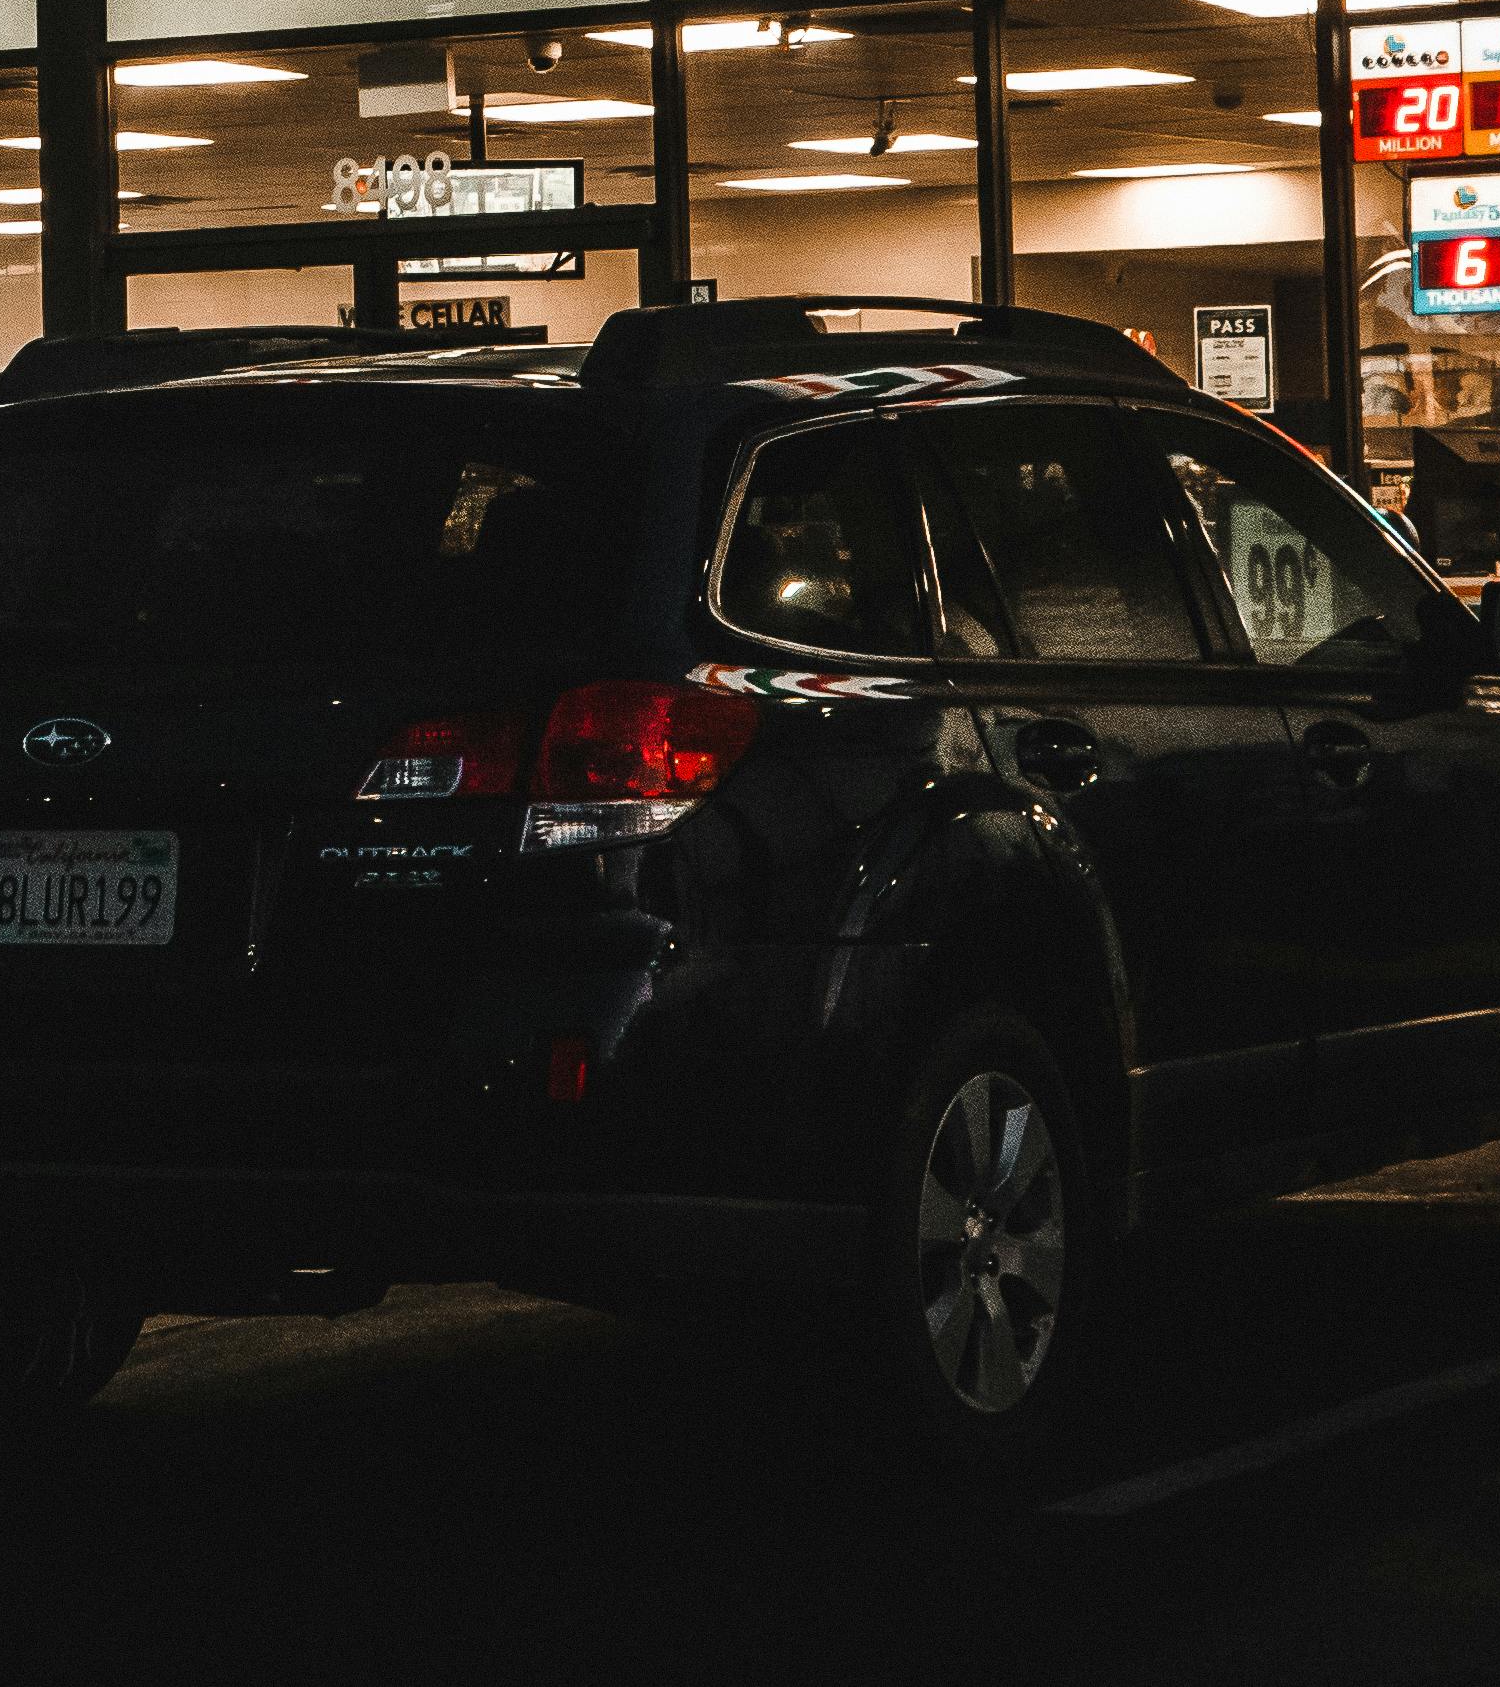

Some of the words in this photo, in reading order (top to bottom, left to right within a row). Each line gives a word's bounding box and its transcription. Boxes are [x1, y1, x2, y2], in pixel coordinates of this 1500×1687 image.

[1395, 84, 1460, 133] 20
[1378, 136, 1443, 153] MILLION
[332, 150, 453, 214] 8498
[411, 300, 505, 329] CELLAR
[1210, 318, 1256, 335] PASS
